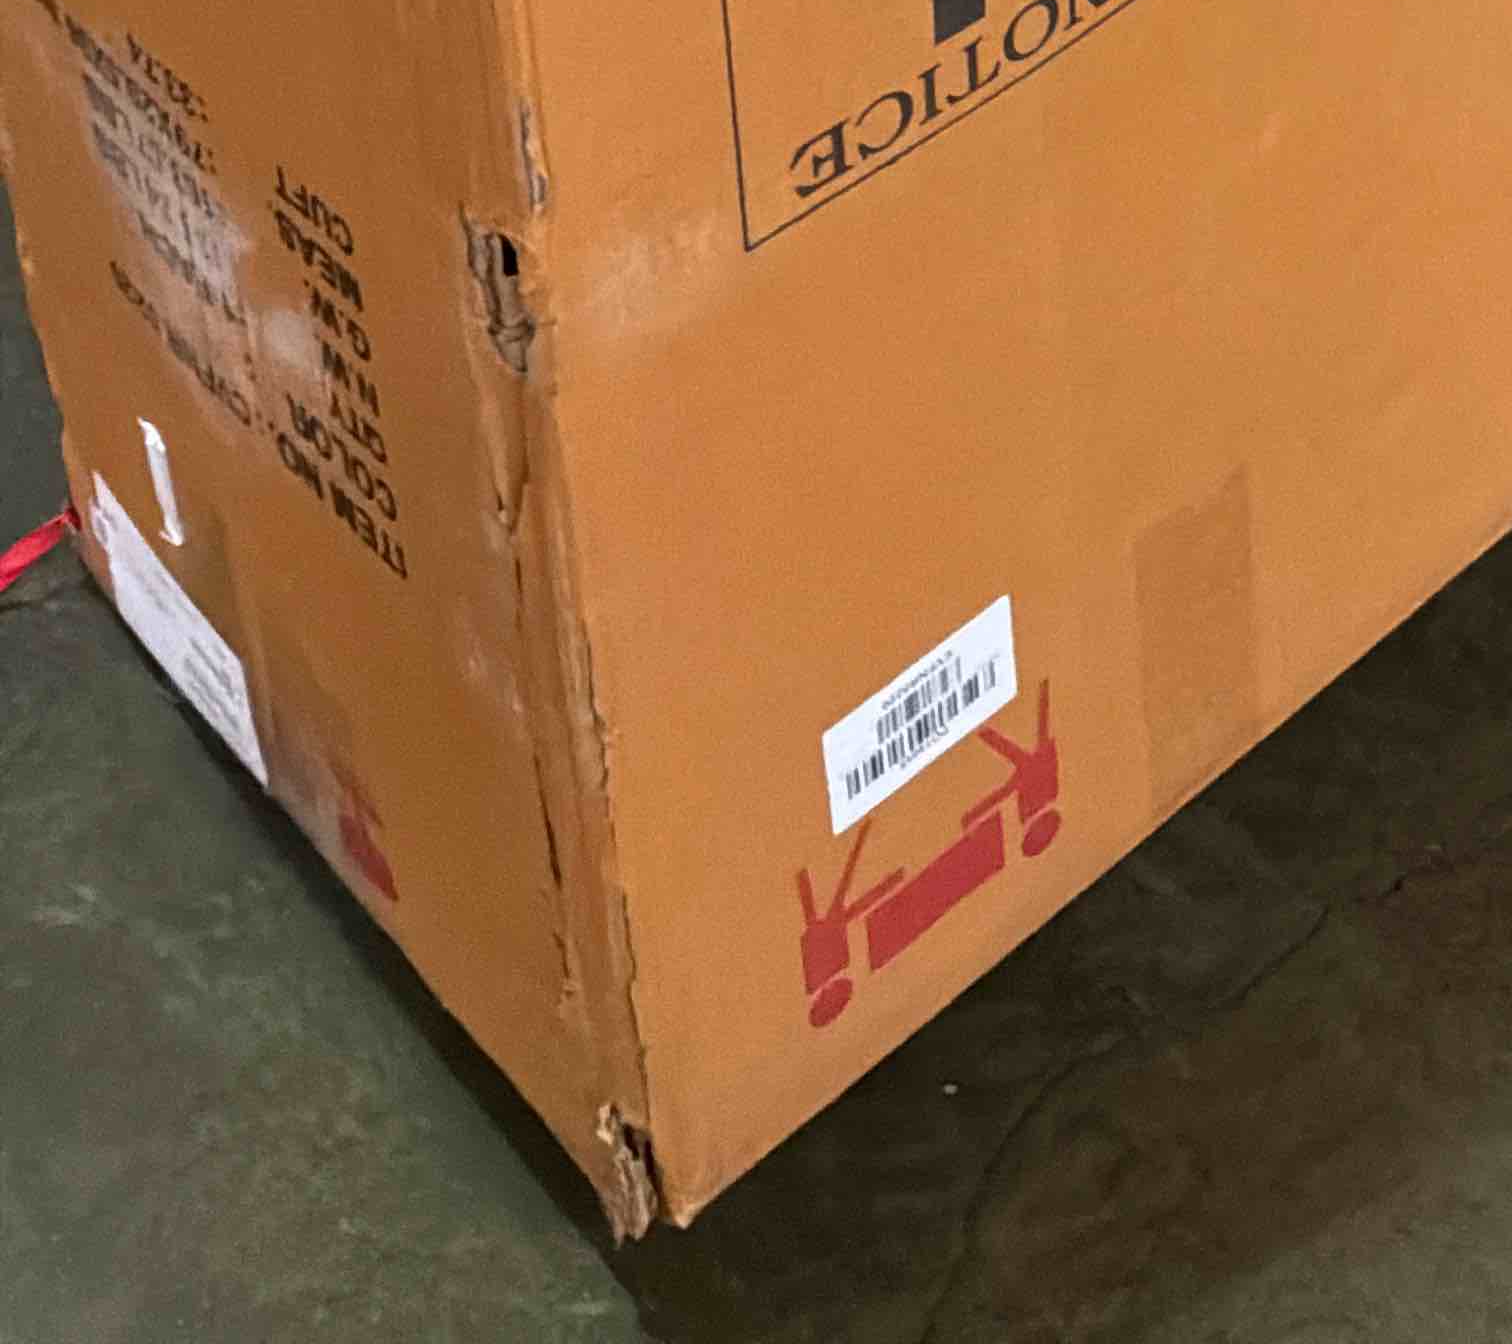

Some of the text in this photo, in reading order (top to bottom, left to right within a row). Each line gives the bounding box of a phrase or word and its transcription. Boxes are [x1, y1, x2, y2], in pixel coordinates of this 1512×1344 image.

[275, 164, 355, 257] CUFT
[285, 392, 398, 521] COLOR
[329, 391, 387, 465] QTY
[329, 481, 408, 581] ITEM
